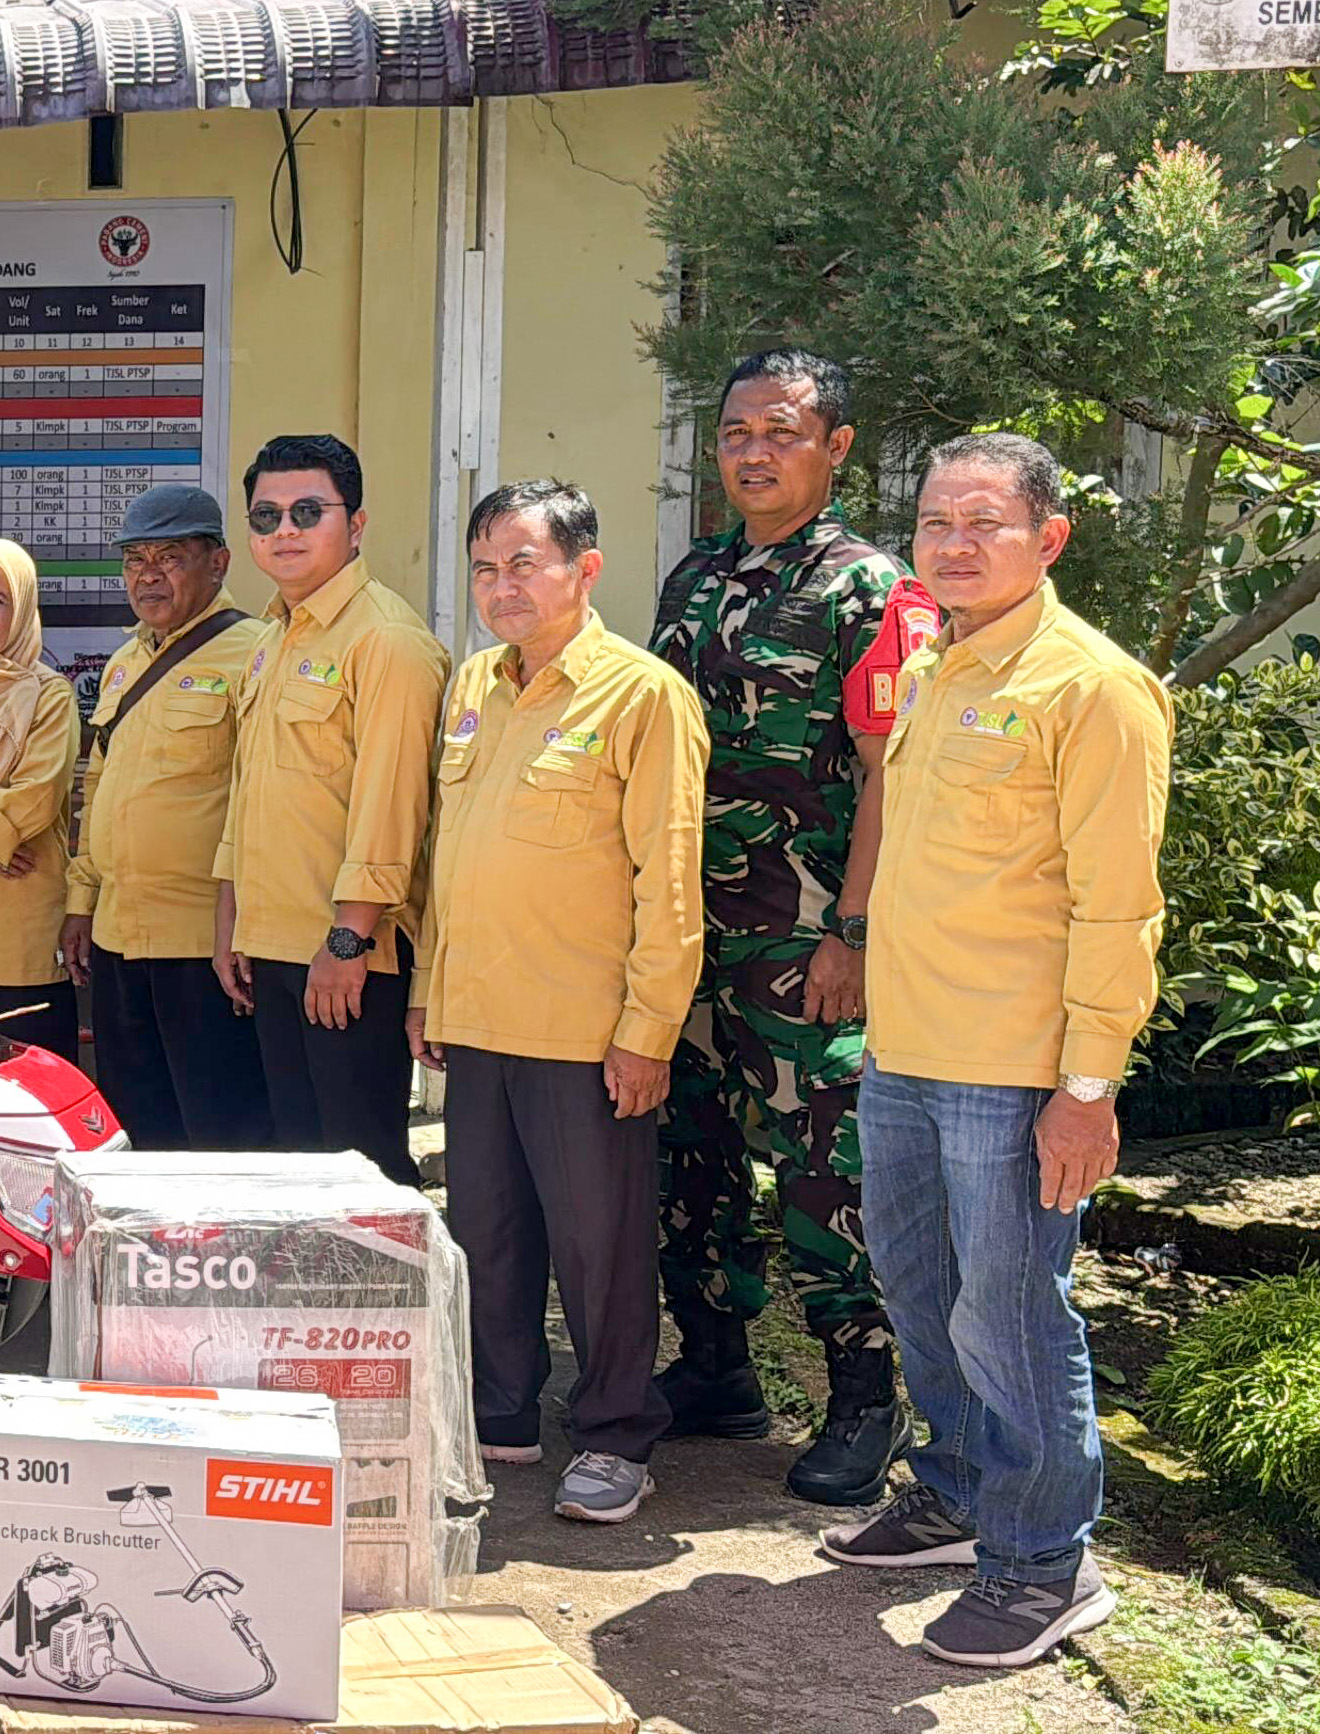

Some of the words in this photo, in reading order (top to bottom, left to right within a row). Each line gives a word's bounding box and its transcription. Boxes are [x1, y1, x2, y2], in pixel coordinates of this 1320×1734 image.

[8, 294, 30, 309] Vol/
[110, 294, 150, 307] Sumber
[45, 305, 61, 317] Sat
[76, 304, 98, 317] Frek
[170, 303, 188, 315] Ket
[8, 315, 30, 327] Unit
[118, 314, 144, 326] Dana
[13, 369, 26, 380] 60
[38, 370, 66, 382] orang
[106, 368, 125, 379] TJSL
[127, 367, 150, 378] PTSP
[36, 422, 66, 433] Klmpk
[105, 420, 124, 431] TJSL
[126, 420, 149, 431] PTSP
[156, 420, 197, 434] Program
[10, 469, 27, 480] 100
[37, 471, 64, 483] orang
[105, 468, 123, 479] TJSL
[125, 468, 148, 478] PTSP
[35, 485, 64, 496] Klmpk
[104, 483, 123, 494] TJSL
[35, 500, 64, 512] Klmpk
[43, 516, 57, 526] KK
[116, 1243, 257, 1290] Tasco
[262, 1327, 412, 1350] TF-820PRO
[273, 1364, 318, 1387] 26
[351, 1364, 397, 1387] 20
[17, 1458, 70, 1485] 3001
[214, 1474, 322, 1506] STIHL
[64, 1527, 161, 1550] Brushcutter
